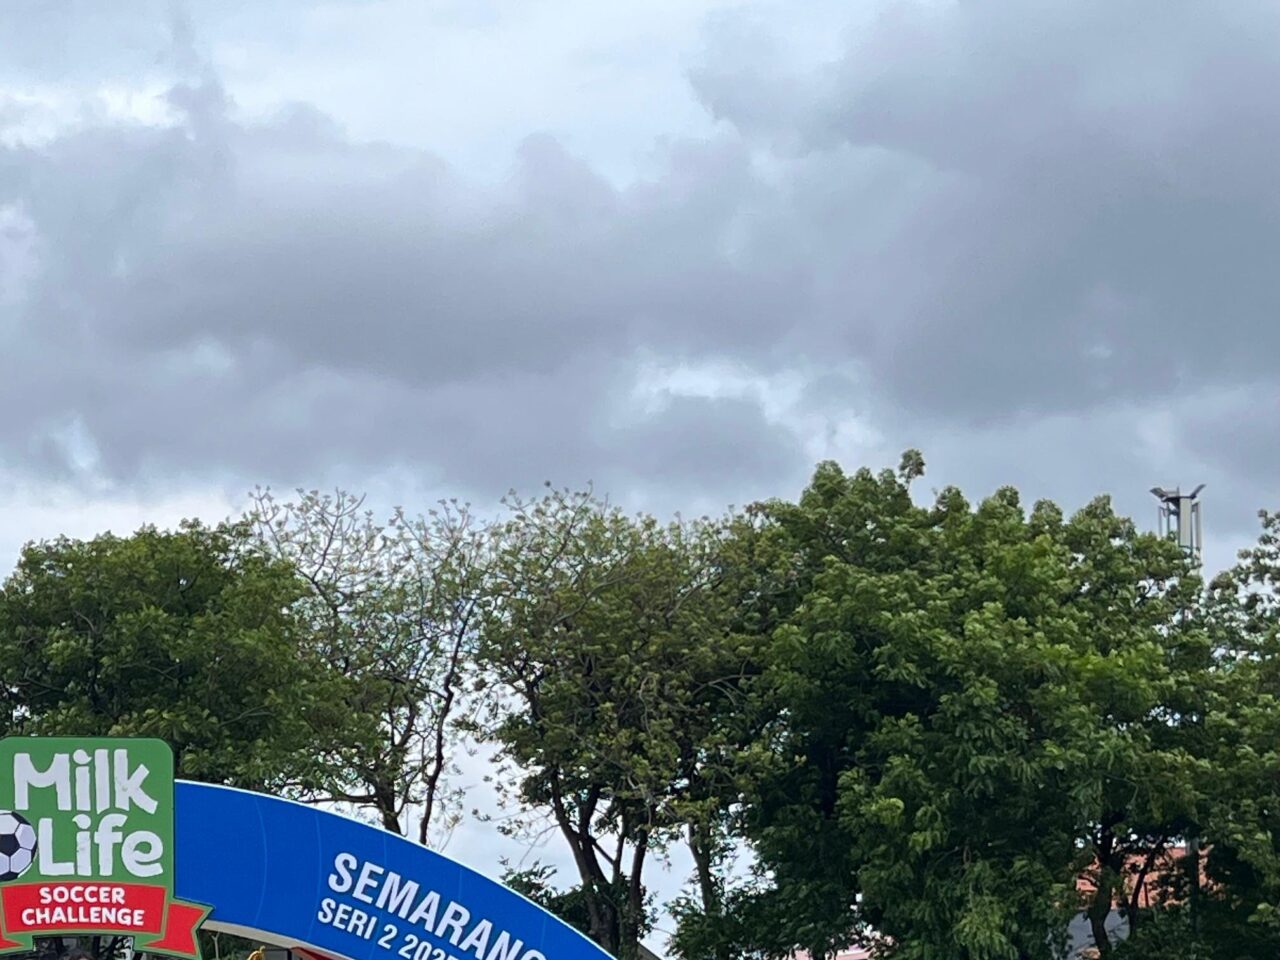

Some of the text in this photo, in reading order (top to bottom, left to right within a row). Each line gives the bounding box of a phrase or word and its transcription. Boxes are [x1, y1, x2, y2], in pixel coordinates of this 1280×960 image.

[14, 749, 158, 814] Milk
[38, 813, 163, 877] Life
[22, 907, 145, 926] CHALLENGE
[39, 886, 126, 904] SOCCER
[318, 898, 377, 940] SERI
[377, 925, 399, 950] 2
